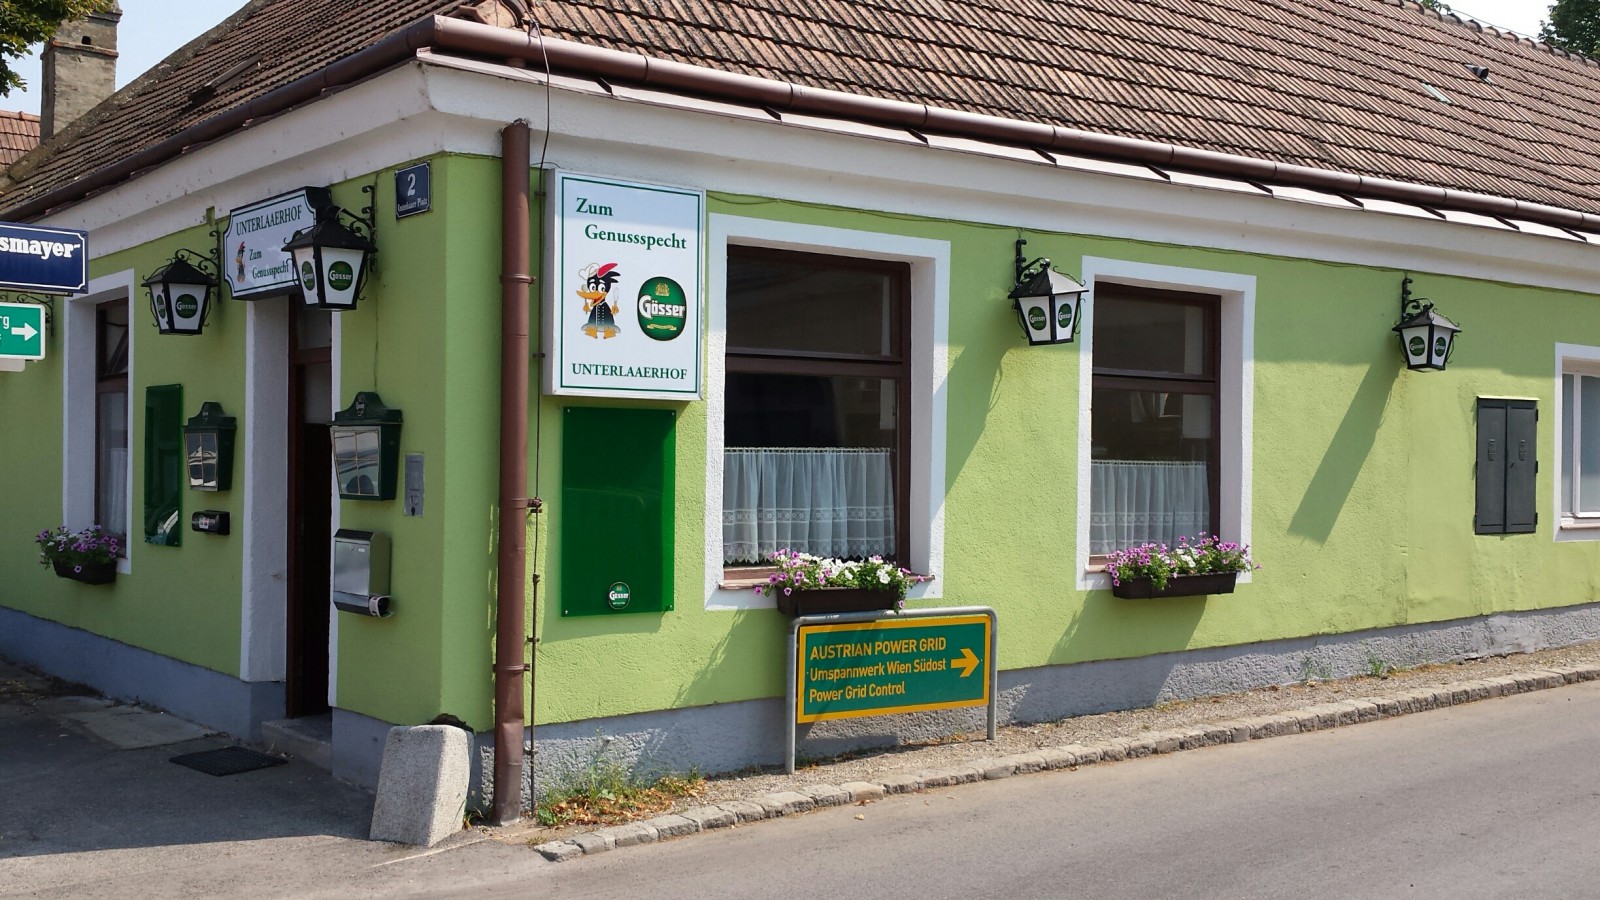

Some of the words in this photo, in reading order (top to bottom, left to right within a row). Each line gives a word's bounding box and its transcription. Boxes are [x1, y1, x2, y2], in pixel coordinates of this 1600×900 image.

[407, 173, 416, 197] 2
[576, 197, 613, 216] Zum
[236, 204, 302, 236] UNTERLAAERHOF
[584, 224, 687, 250] Genussspecht
[249, 248, 262, 261] Zum
[252, 260, 290, 280] Genussspecht
[639, 294, 686, 320] Gösser
[572, 363, 688, 380] UNTERLAAERHOF
[810, 642, 872, 661] AUSTRIAN
[874, 639, 917, 656] POWER
[919, 636, 947, 652] GRID
[810, 662, 885, 683] Umspannwerk
[886, 660, 911, 675] Wien
[913, 658, 946, 673] Südost
[809, 688, 843, 703] Power
[845, 684, 867, 699] Grid
[868, 680, 905, 697] Control
